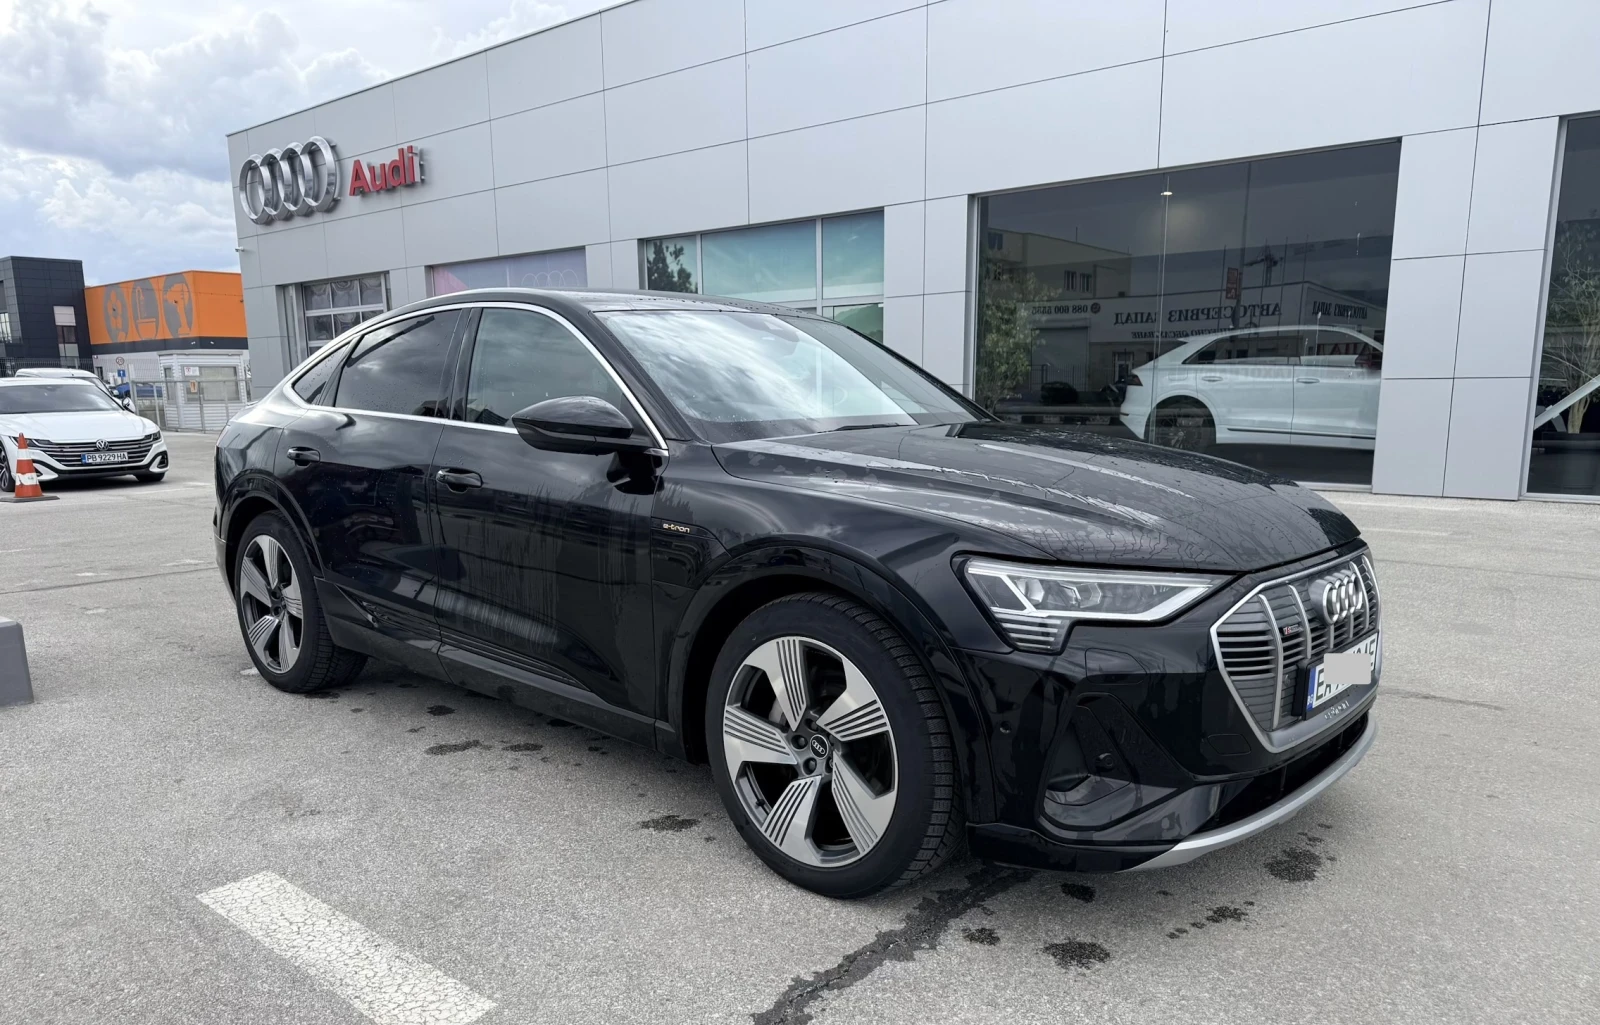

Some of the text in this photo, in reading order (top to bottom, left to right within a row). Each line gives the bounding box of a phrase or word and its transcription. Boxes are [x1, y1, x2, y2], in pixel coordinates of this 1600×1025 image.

[349, 145, 417, 196] Audi
[86, 454, 97, 462] PB
[98, 453, 116, 461] 9229
[662, 523, 690, 533] e-tron
